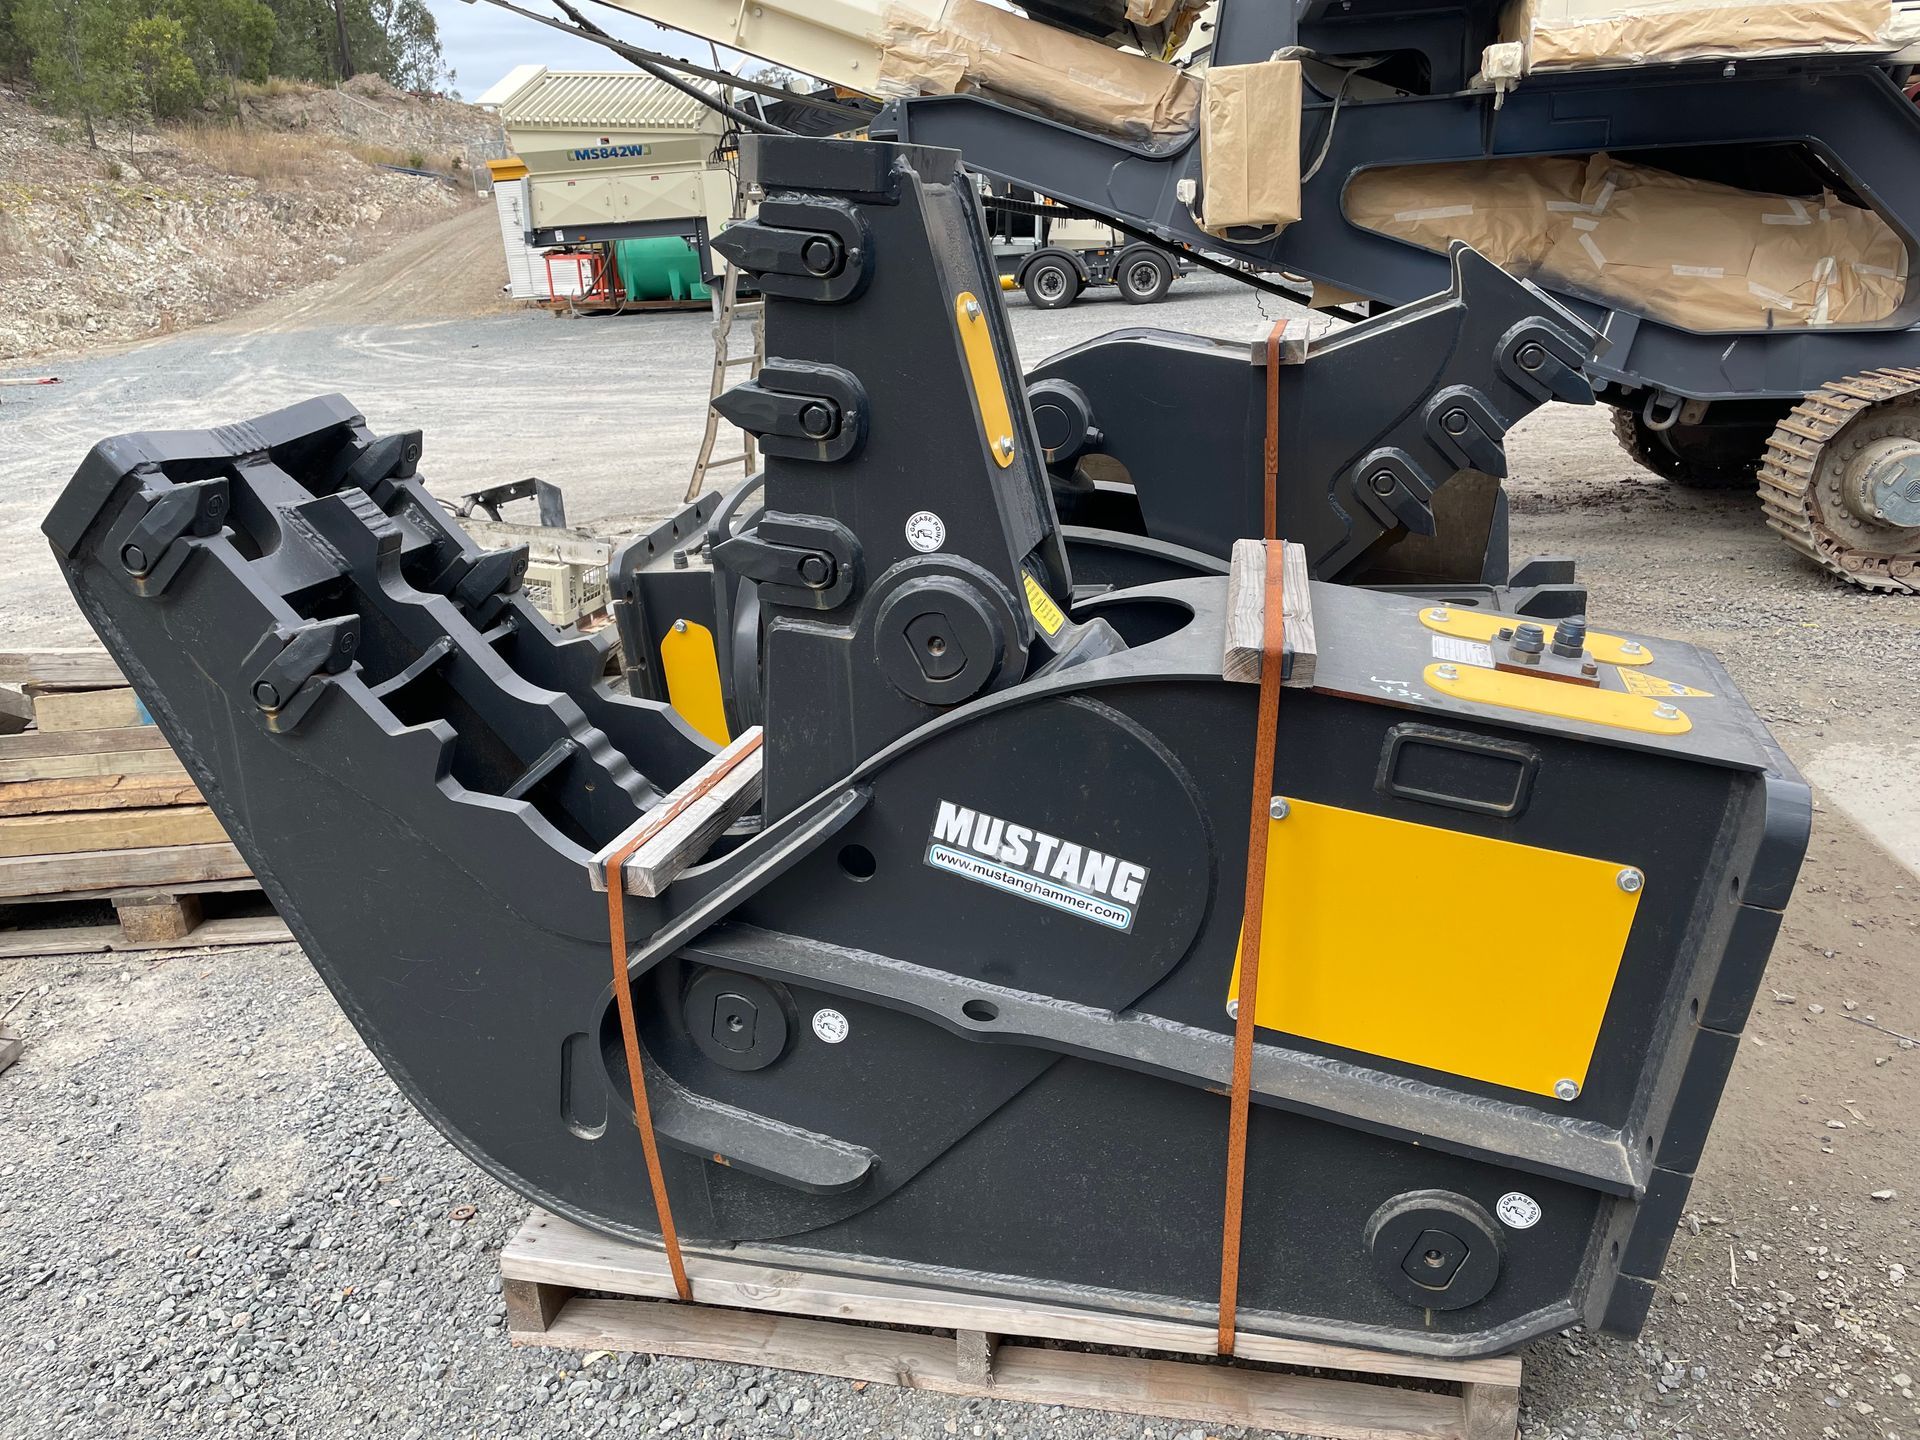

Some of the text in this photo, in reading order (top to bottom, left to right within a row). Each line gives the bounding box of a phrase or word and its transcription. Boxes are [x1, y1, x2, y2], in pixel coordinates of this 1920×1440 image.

[574, 144, 643, 161] MS842W
[910, 516, 941, 543] GREASE POINT
[933, 800, 1146, 904] MUSTANG
[935, 850, 1126, 923] www.mustanghammer.com
[817, 1012, 840, 1023] GREASE
[1503, 1196, 1532, 1206] GREASE
[1525, 1206, 1537, 1223] POINT
